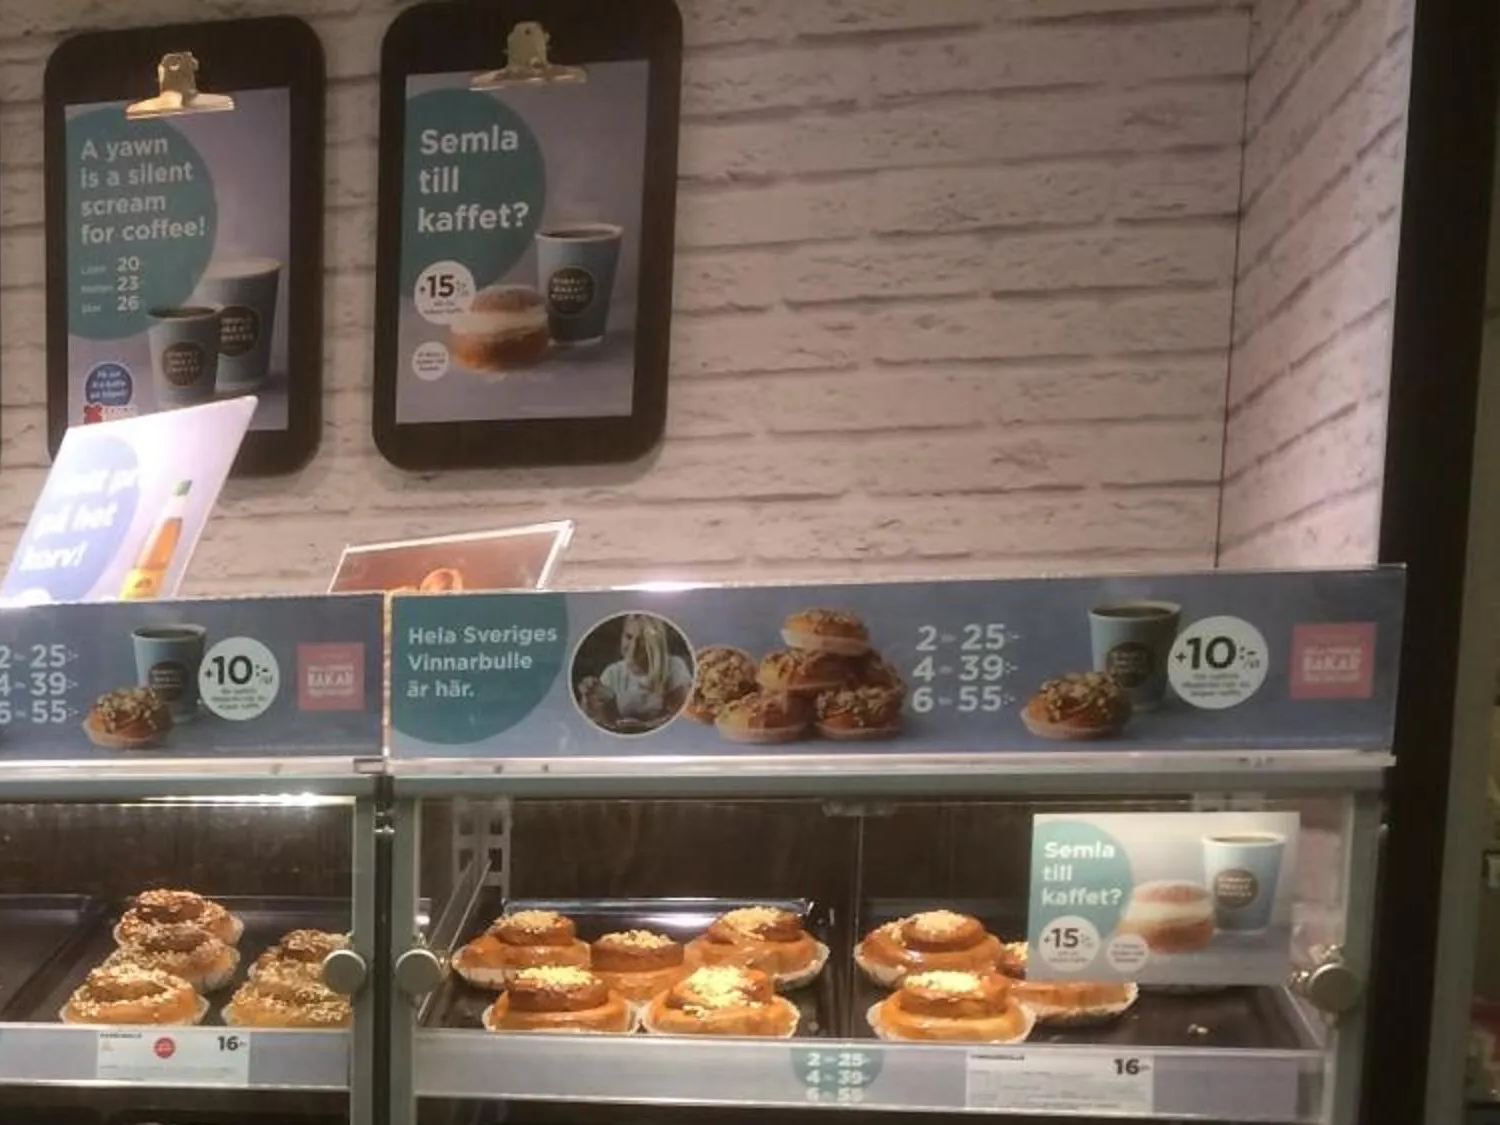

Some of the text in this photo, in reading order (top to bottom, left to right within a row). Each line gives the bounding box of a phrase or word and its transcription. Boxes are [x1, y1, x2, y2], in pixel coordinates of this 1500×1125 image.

[81, 138, 168, 162] A yawn
[420, 125, 518, 155] Semla
[81, 162, 193, 189] is a silent
[419, 167, 459, 194] till
[81, 196, 165, 217] scream
[417, 202, 529, 233] kaffet?
[81, 216, 205, 245] for coffee!
[117, 256, 140, 272] 20
[117, 276, 140, 291] 23
[117, 296, 140, 311] 26
[408, 625, 558, 646] Hela Sveriges
[916, 625, 936, 651] 2
[408, 652, 532, 672] Vinnarbulle
[912, 655, 935, 682] 4
[406, 679, 474, 698] är här.
[911, 686, 932, 713] 6
[1044, 841, 1115, 859] Semla
[1043, 864, 1073, 881] till
[1041, 888, 1122, 906] kaffet?
[807, 1052, 821, 1066] 2
[806, 1069, 821, 1084] 4
